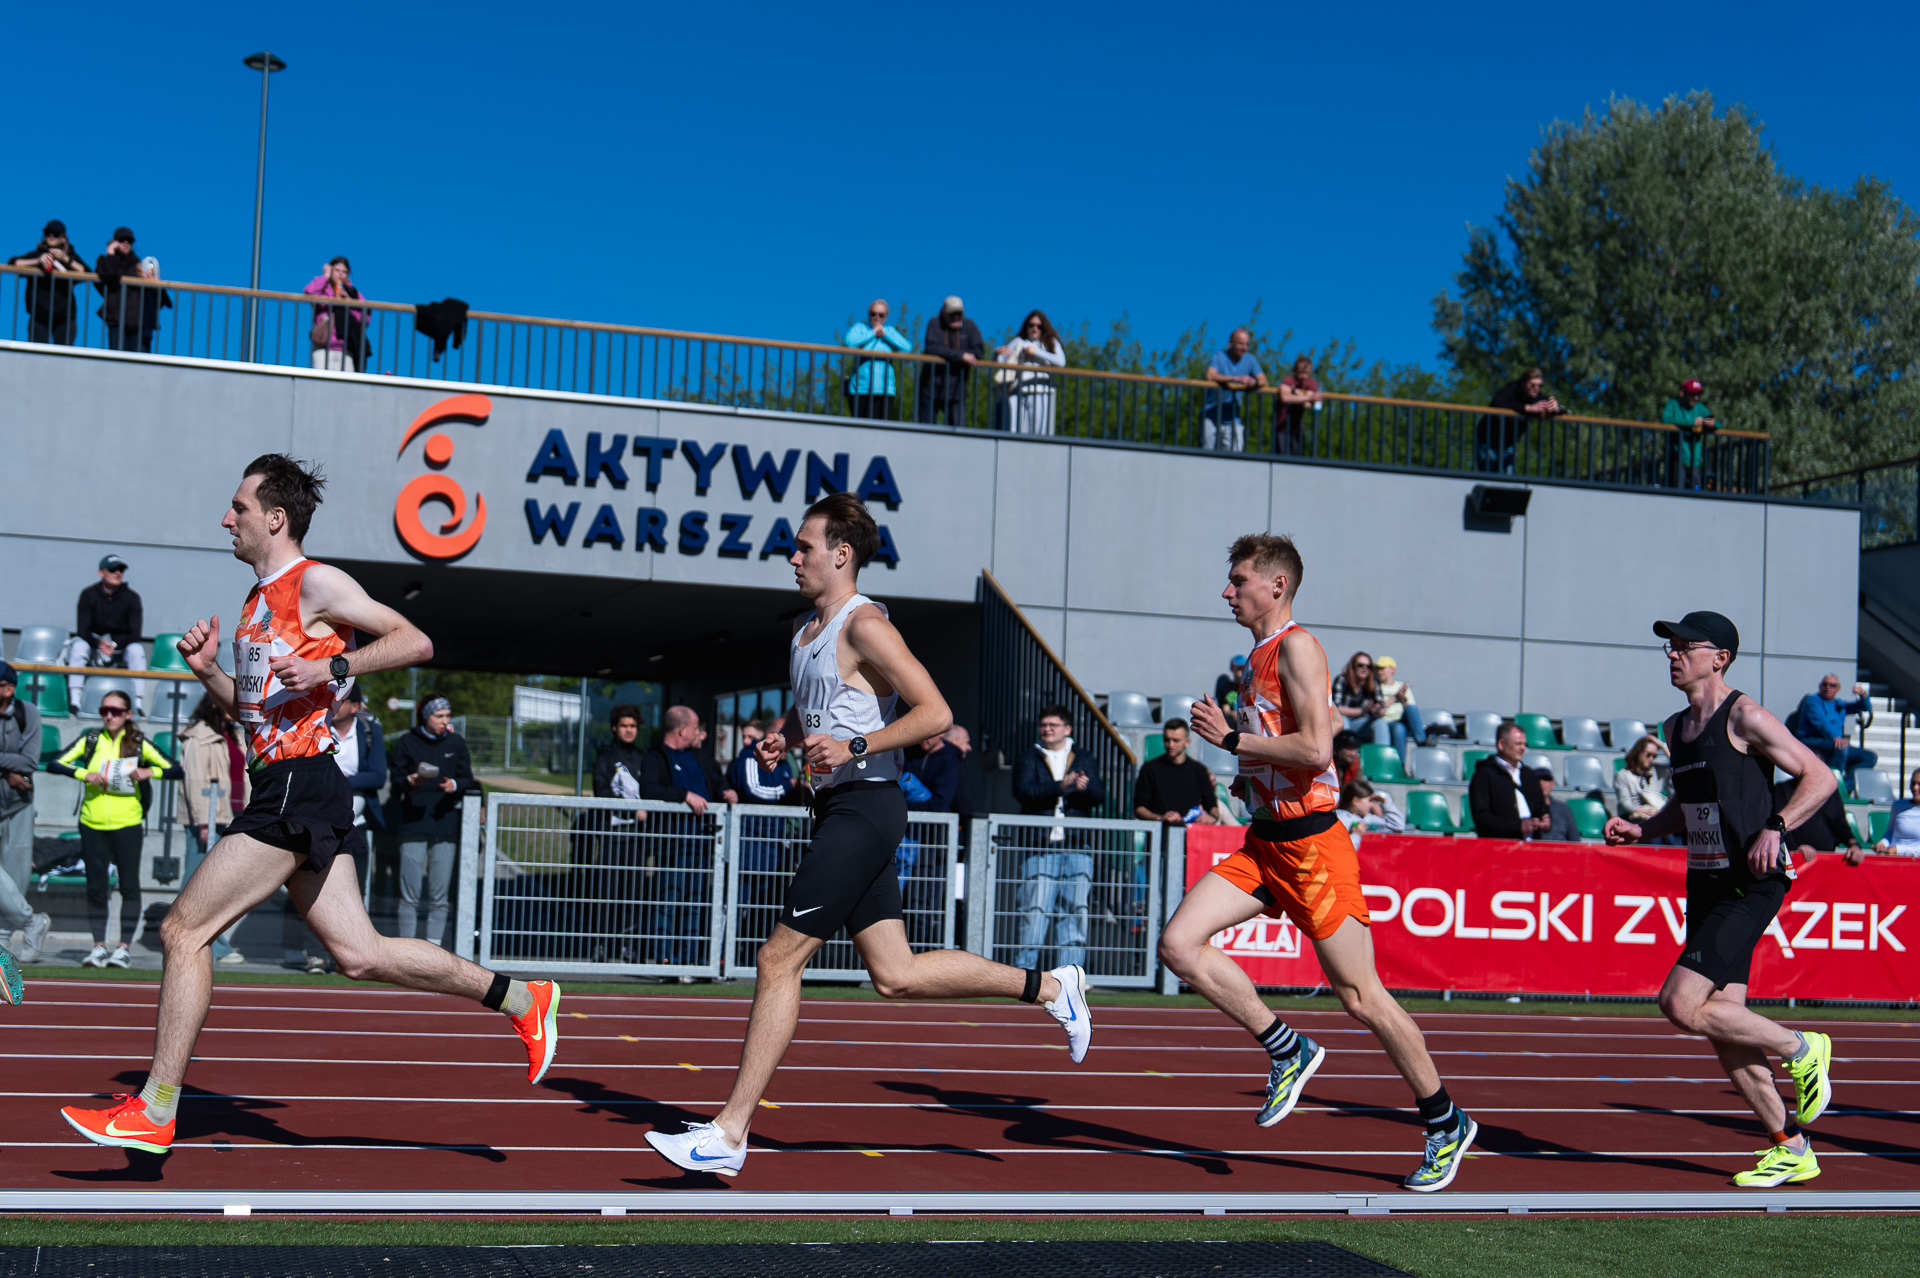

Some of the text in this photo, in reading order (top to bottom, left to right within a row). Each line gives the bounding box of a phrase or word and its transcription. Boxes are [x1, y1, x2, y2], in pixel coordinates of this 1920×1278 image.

[526, 428, 902, 511] AKTYWNA
[525, 498, 900, 570] WARSZAA
[249, 647, 260, 662] 85
[806, 713, 821, 728] 83
[1696, 807, 1710, 820] 29
[1360, 884, 1593, 942] POLSKI
[1217, 922, 1296, 952] PZLA
